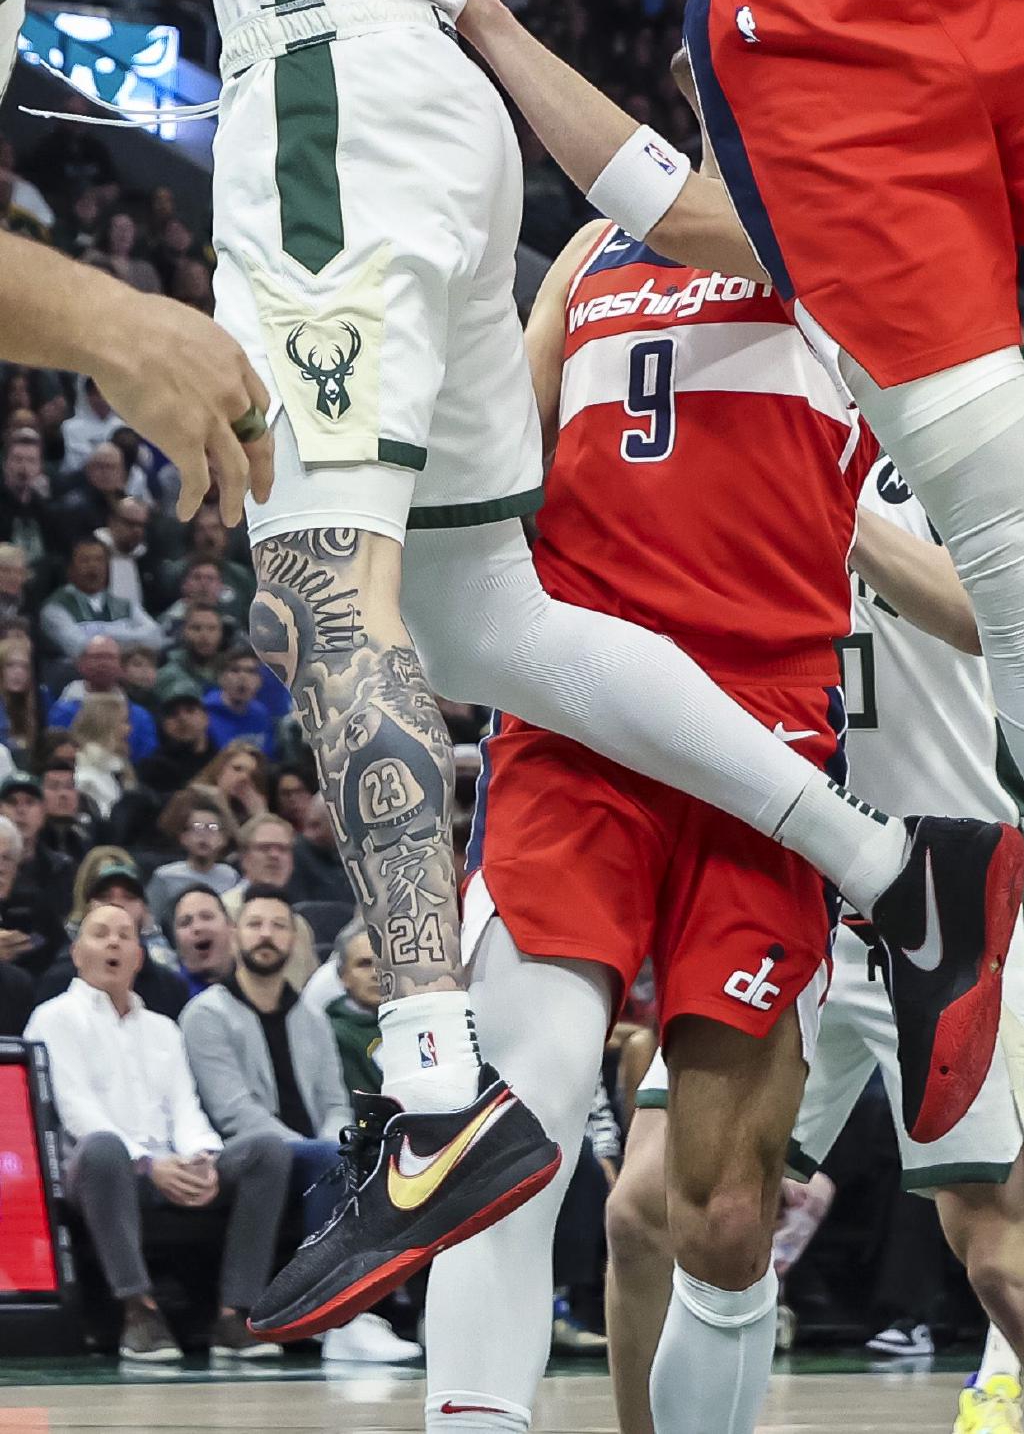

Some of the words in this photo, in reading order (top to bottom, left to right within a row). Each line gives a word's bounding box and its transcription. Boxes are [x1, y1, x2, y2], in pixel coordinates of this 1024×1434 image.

[568, 272, 774, 334] washington
[620, 335, 677, 463] 9
[363, 763, 408, 817] 23
[381, 845, 448, 918] 家
[387, 913, 445, 966] 24
